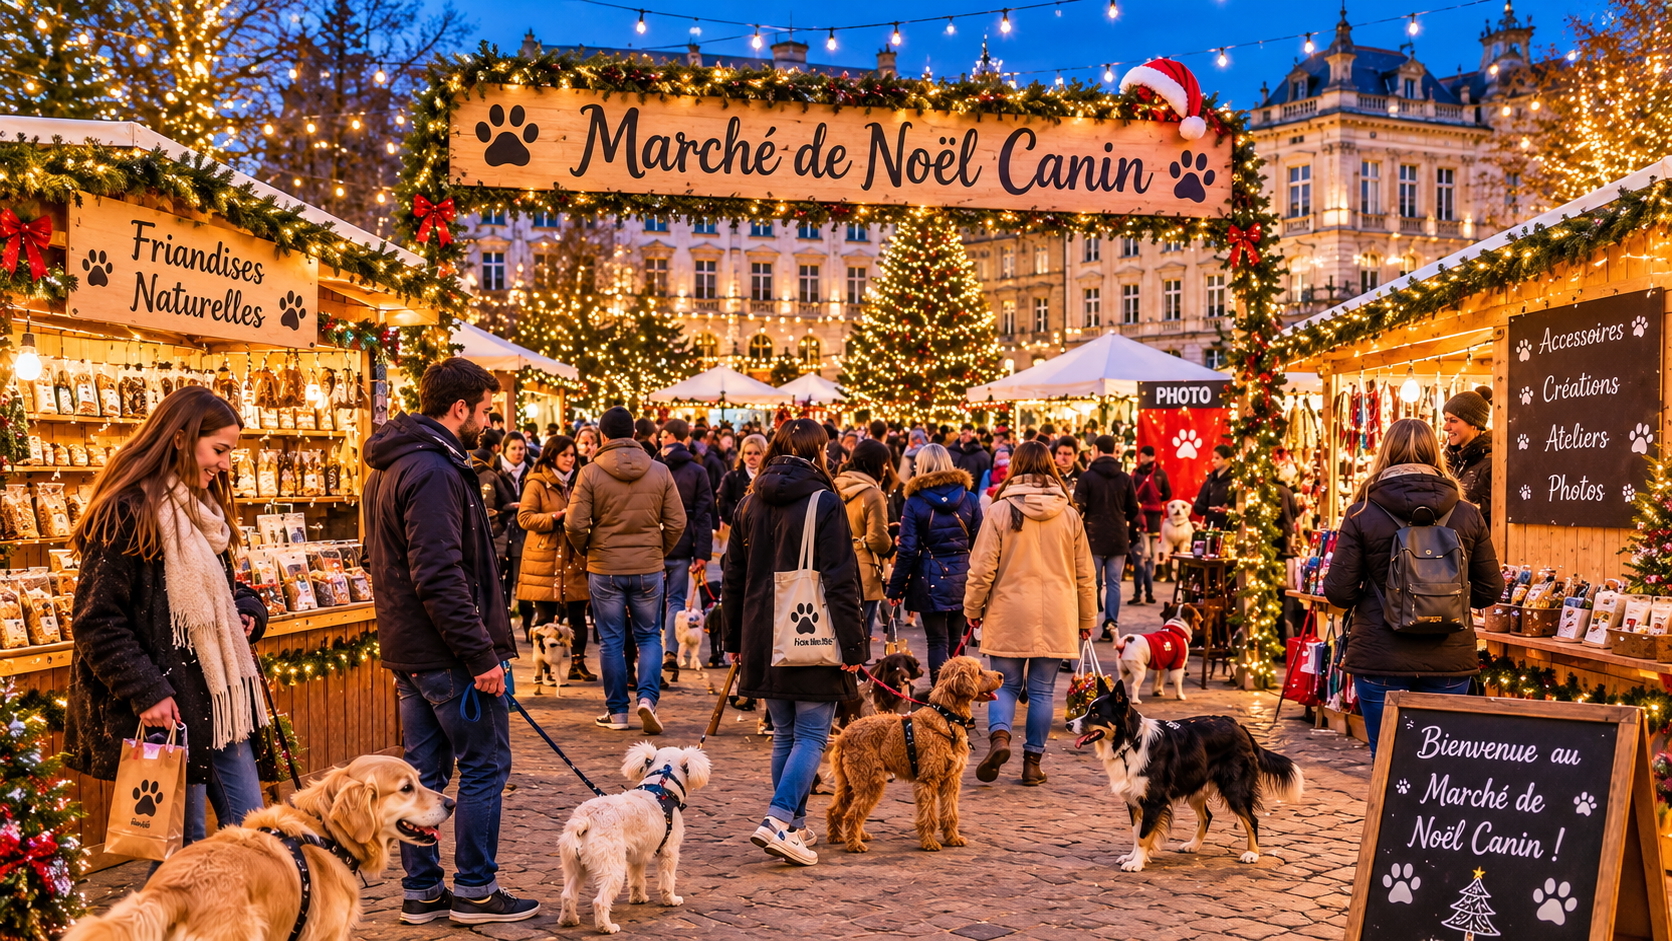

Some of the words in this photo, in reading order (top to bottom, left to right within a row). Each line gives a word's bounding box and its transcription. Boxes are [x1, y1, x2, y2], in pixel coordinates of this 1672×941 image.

[570, 103, 781, 179] Marché
[794, 122, 852, 179] de
[860, 121, 981, 191] Noël
[998, 127, 1154, 196] Canin
[131, 219, 265, 285] Friandises
[129, 271, 266, 329] Naturelles
[1538, 322, 1624, 355] Accessoires
[1156, 386, 1212, 405] PHOTO
[1542, 372, 1620, 403] Créations
[1544, 422, 1609, 452] Ateliers
[1548, 474, 1605, 502] Photos
[1416, 725, 1538, 763] Bienvenue
[1550, 747, 1581, 766] au
[1419, 772, 1509, 810] Marché
[1515, 782, 1545, 813] de
[1406, 815, 1464, 851] Noël
[1471, 820, 1544, 859] Canin
[1551, 827, 1566, 862] !
